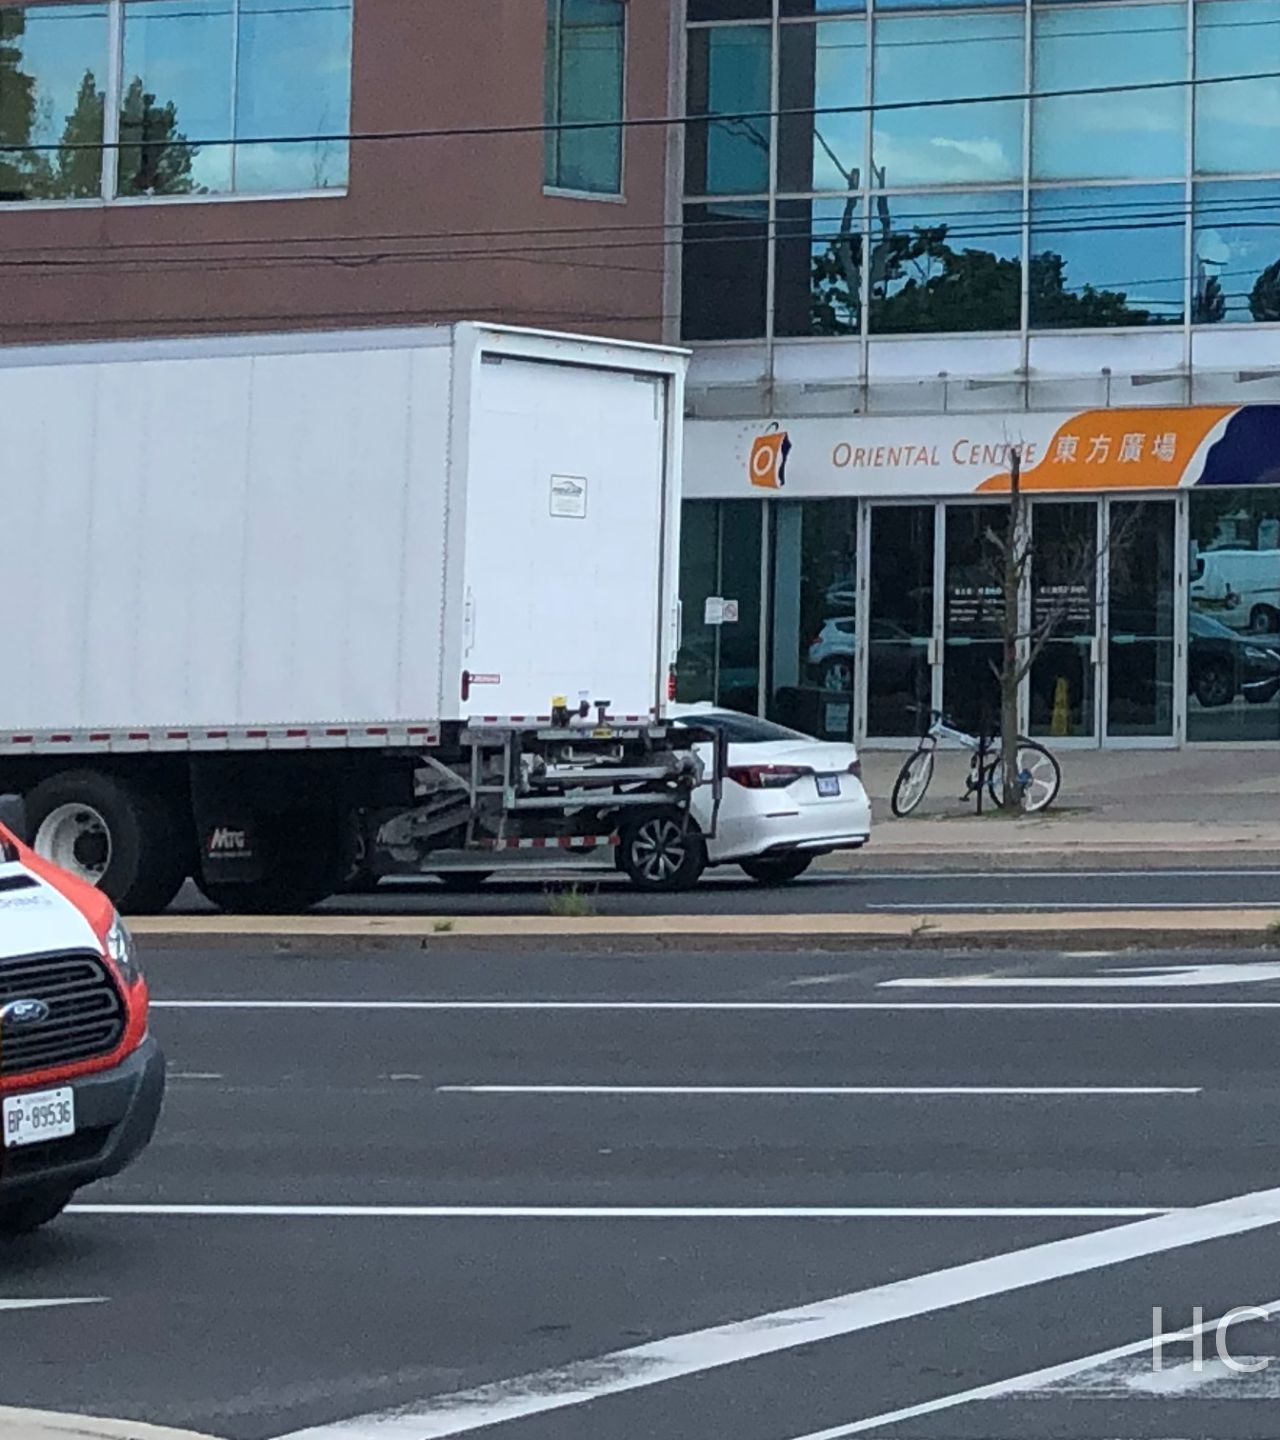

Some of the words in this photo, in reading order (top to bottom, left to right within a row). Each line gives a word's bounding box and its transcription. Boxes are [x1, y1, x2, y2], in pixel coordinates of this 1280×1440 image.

[832, 442, 940, 468] ORIENTAL
[1051, 432, 1177, 464] 東方廣場
